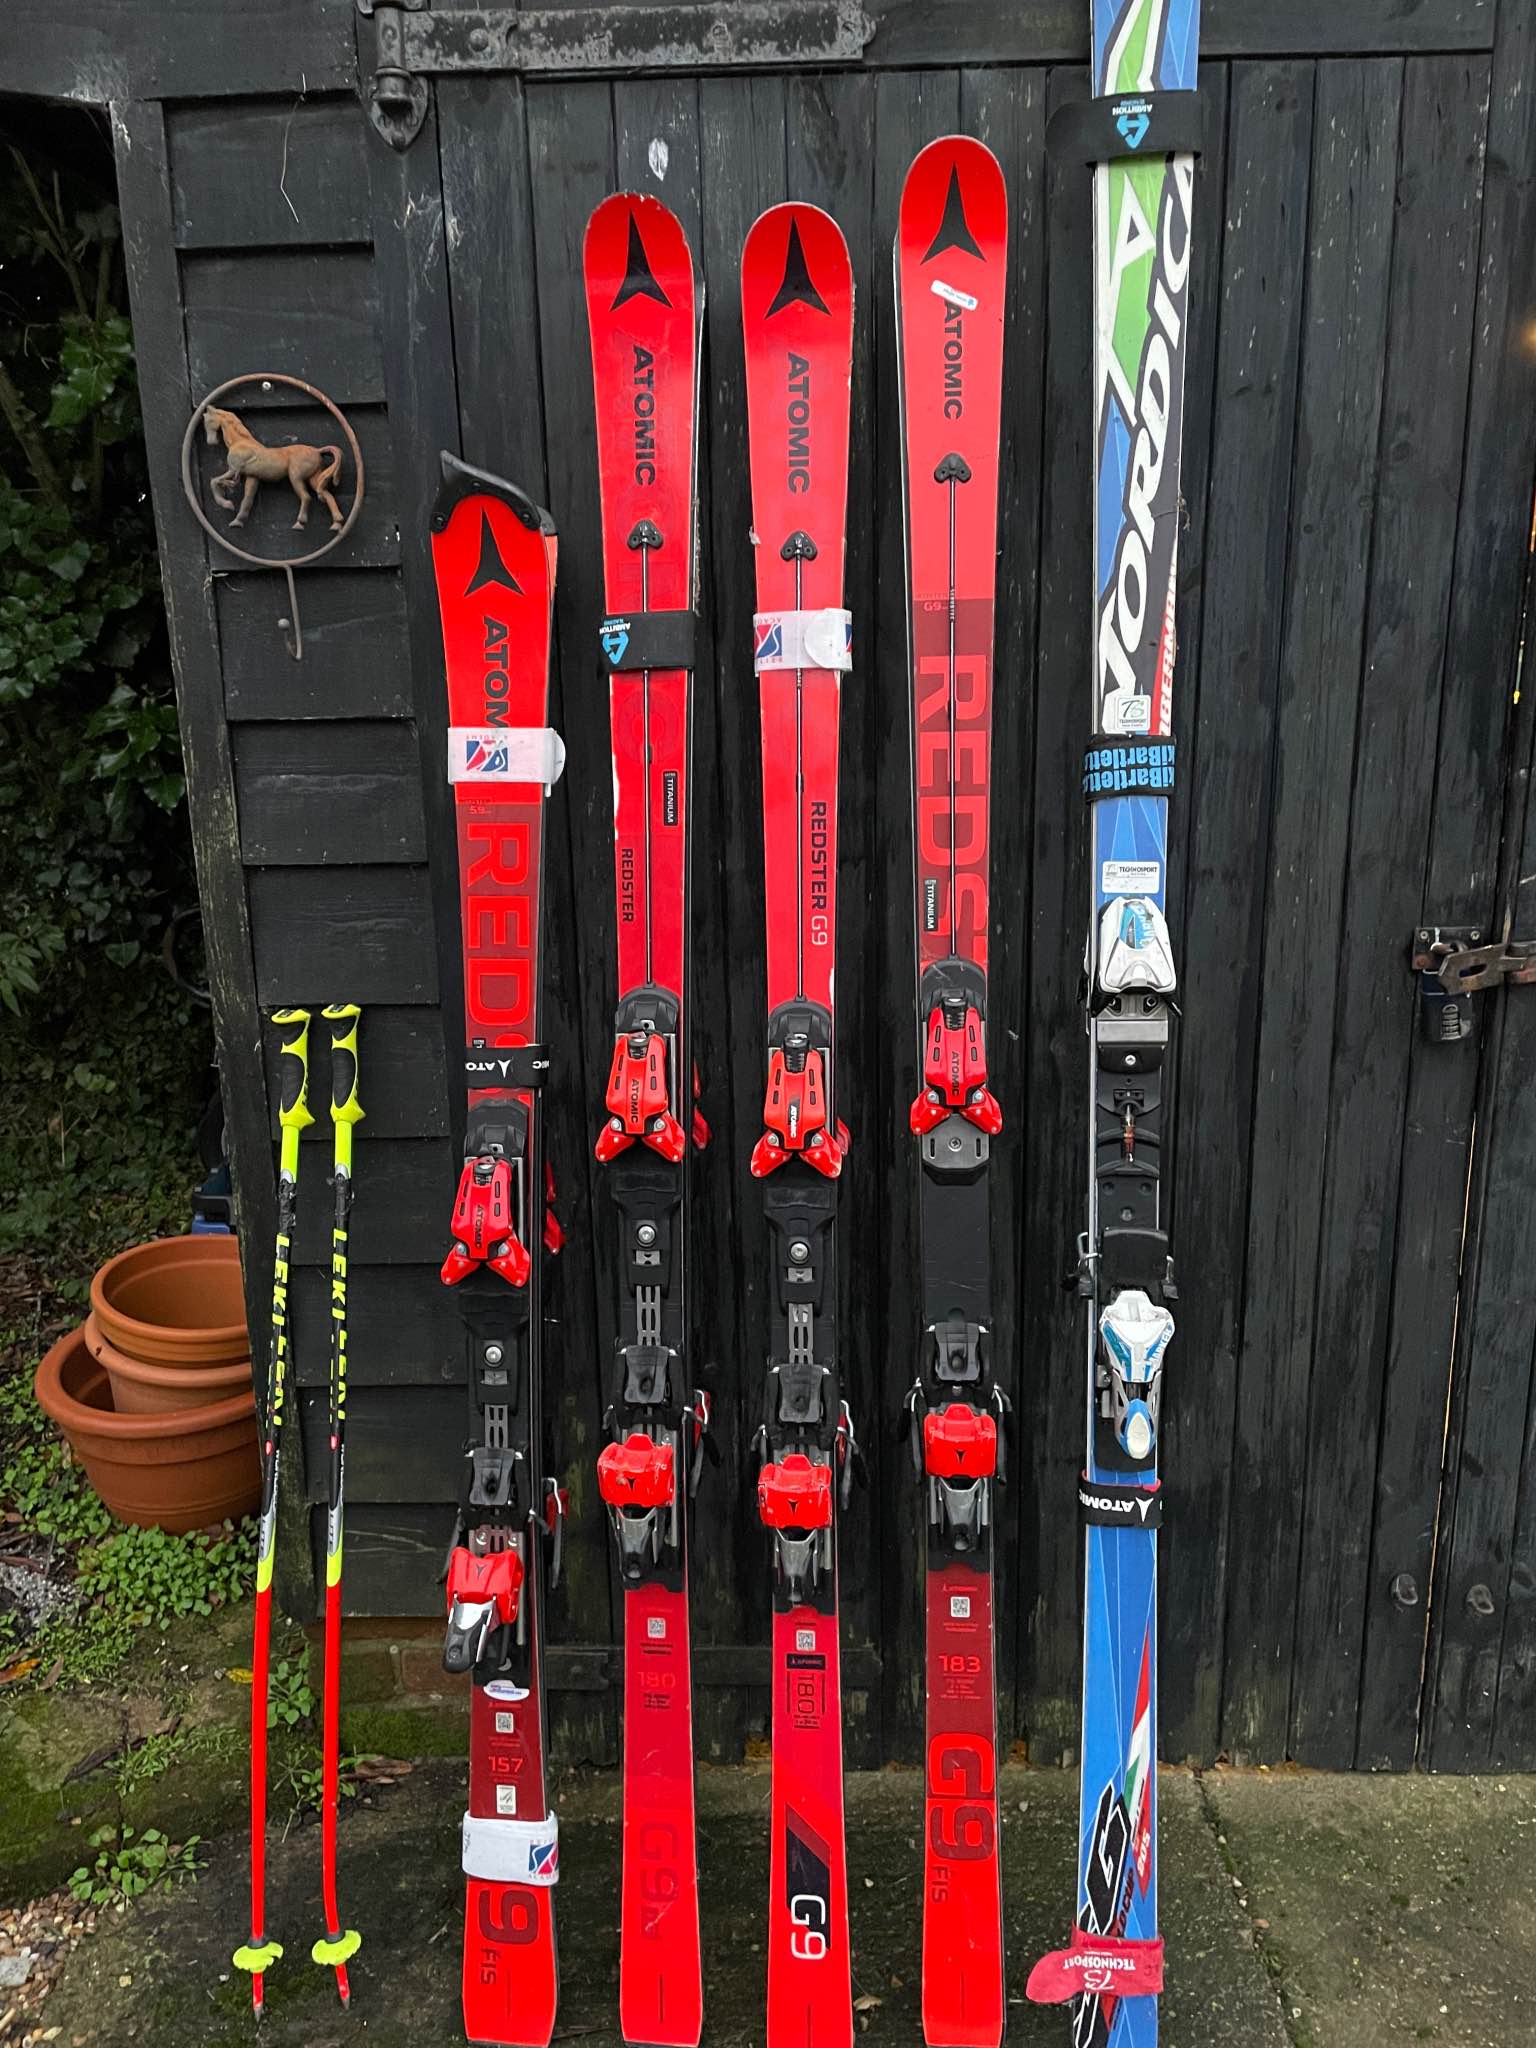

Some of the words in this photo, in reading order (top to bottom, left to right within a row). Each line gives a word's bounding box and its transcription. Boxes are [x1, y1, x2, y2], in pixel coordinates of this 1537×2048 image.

[1112, 104, 1153, 115] AMBITION
[944, 300, 963, 420] ATOMIC
[632, 344, 655, 487] ATOMIC
[787, 350, 811, 494] ATOMIC
[483, 615, 510, 728] ATOM
[667, 779, 675, 823] TITANIUM
[811, 801, 827, 909] REDSTER
[621, 848, 634, 922] REDSTER
[927, 884, 936, 929] TITANIUM
[811, 914, 827, 946] G9
[951, 1051, 960, 1097] ATOMIC
[631, 1078, 640, 1124] ATOMIC
[789, 1104, 797, 1139] ATOMIC
[272, 1232, 290, 1327] LEKI
[331, 1228, 348, 1321] LEKI
[637, 1671, 677, 1688] 180
[938, 1654, 982, 1673] 183
[797, 1673, 815, 1716] 180
[488, 1755, 524, 1773] 157
[928, 1732, 996, 1861] G9
[932, 1865, 949, 1903] FIS
[790, 1893, 828, 1961] G9
[480, 1947, 498, 1986] FIS
[1063, 1955, 1136, 1971] TECHNOSPORT
